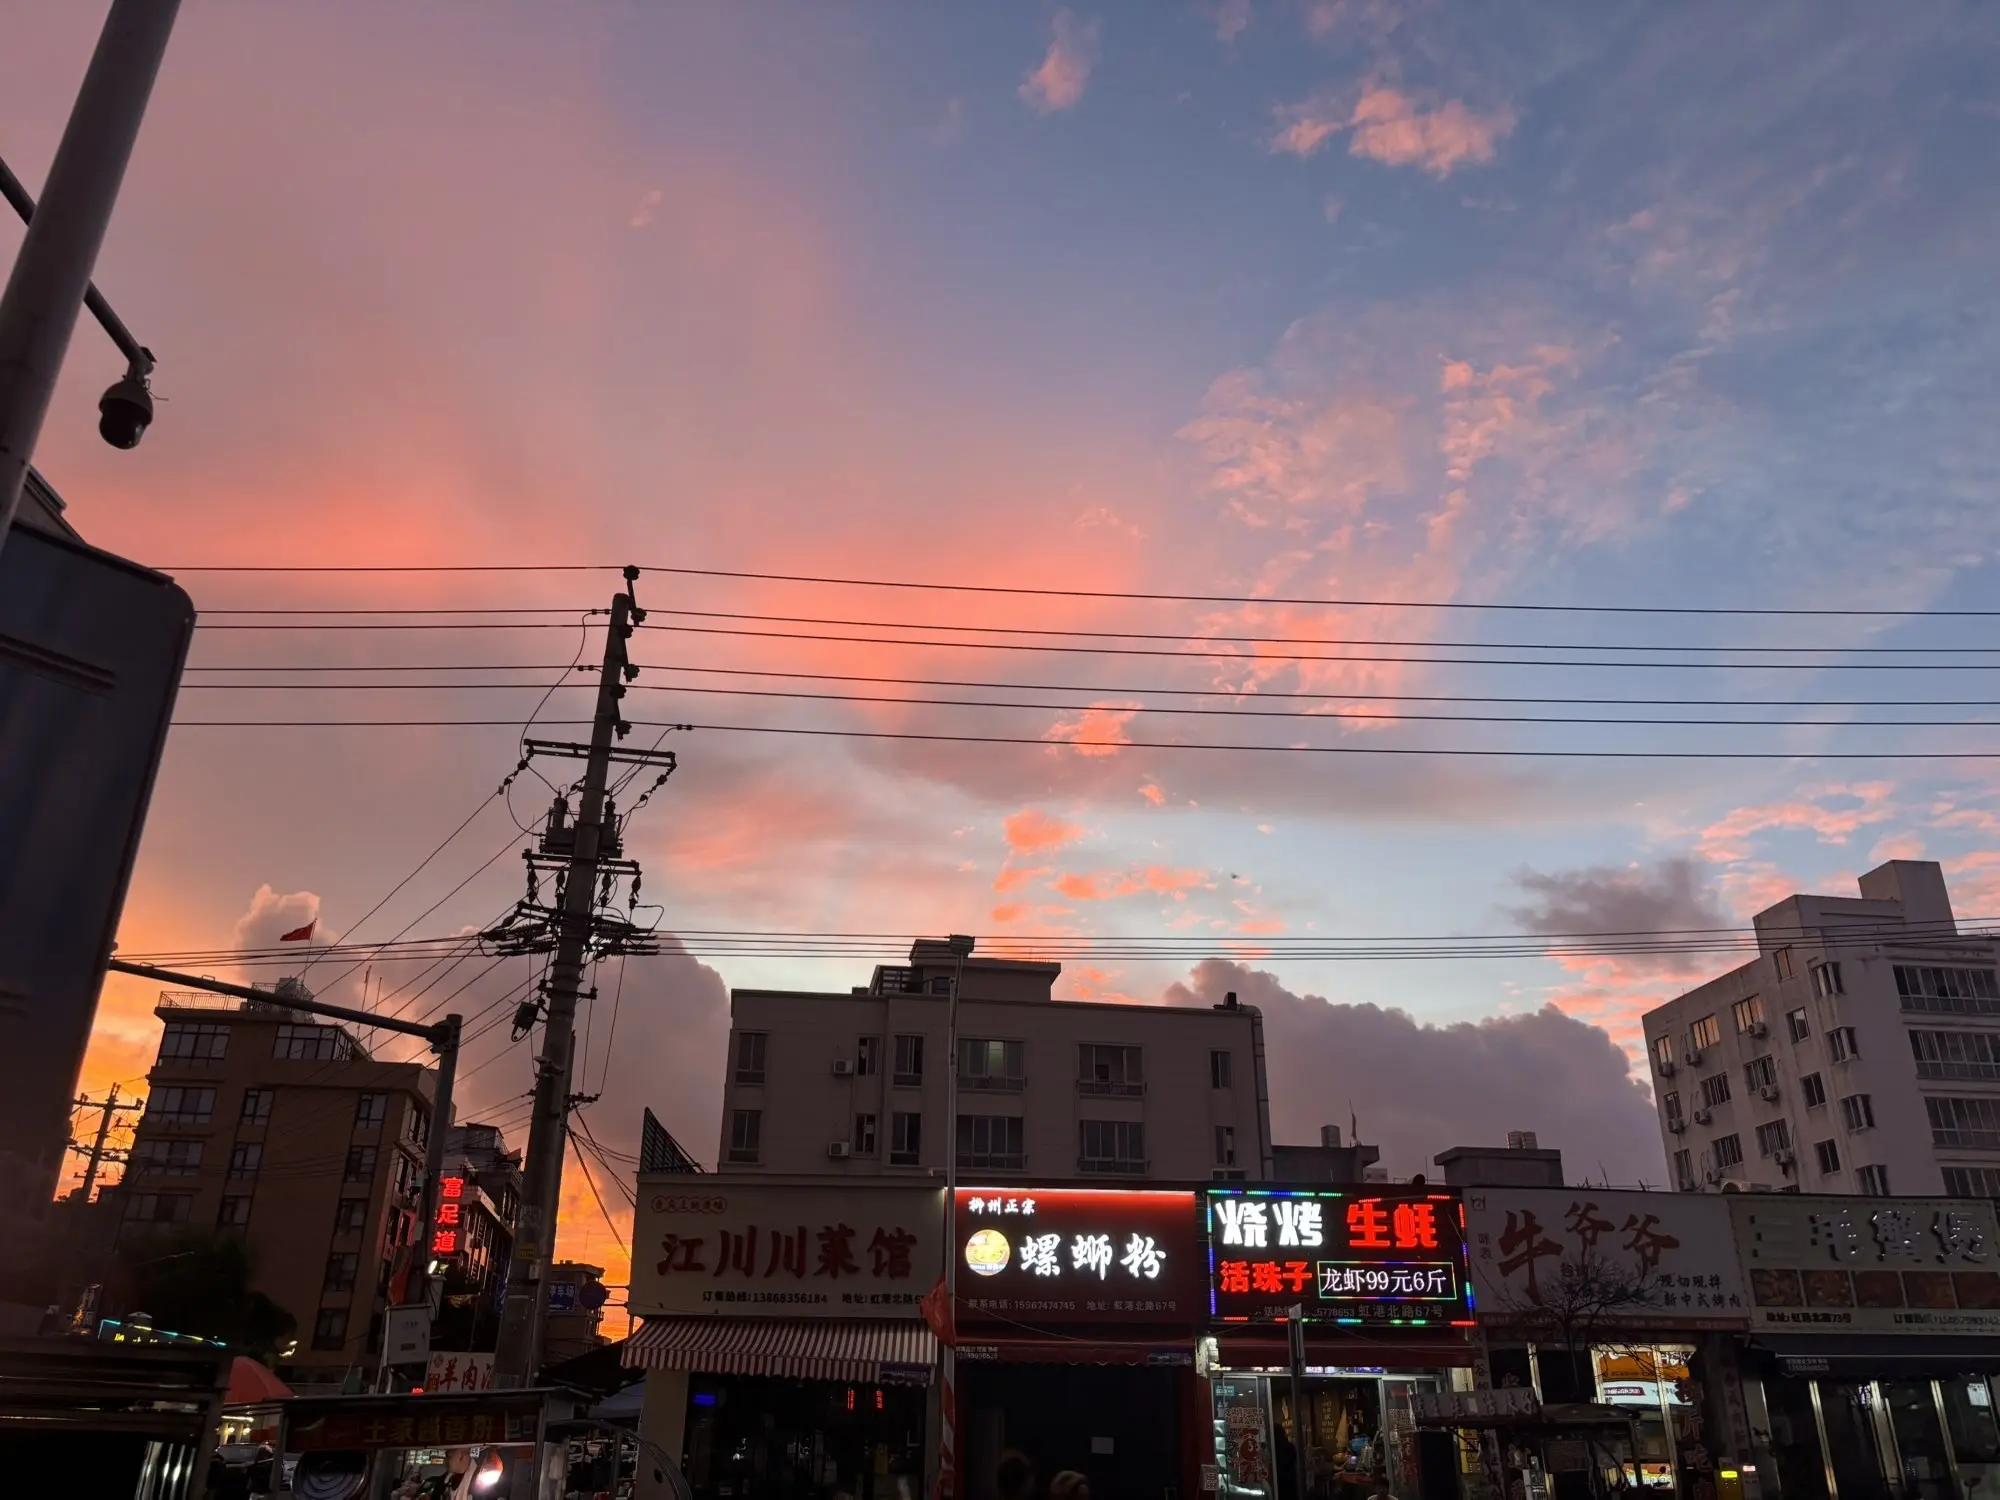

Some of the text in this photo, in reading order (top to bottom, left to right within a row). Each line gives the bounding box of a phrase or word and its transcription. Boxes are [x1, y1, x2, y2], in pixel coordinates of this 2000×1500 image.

[968, 1197, 1036, 1216] 柳州正宗
[1215, 1199, 1439, 1249] 烧烤 生蚝
[656, 1224, 918, 1279] 江川川菜馆
[1018, 1232, 1167, 1281] 螺蛳粉
[1497, 1201, 1680, 1305] 牛爷爷
[1219, 1260, 1448, 1294] 活珠子 龙虾99元6斤
